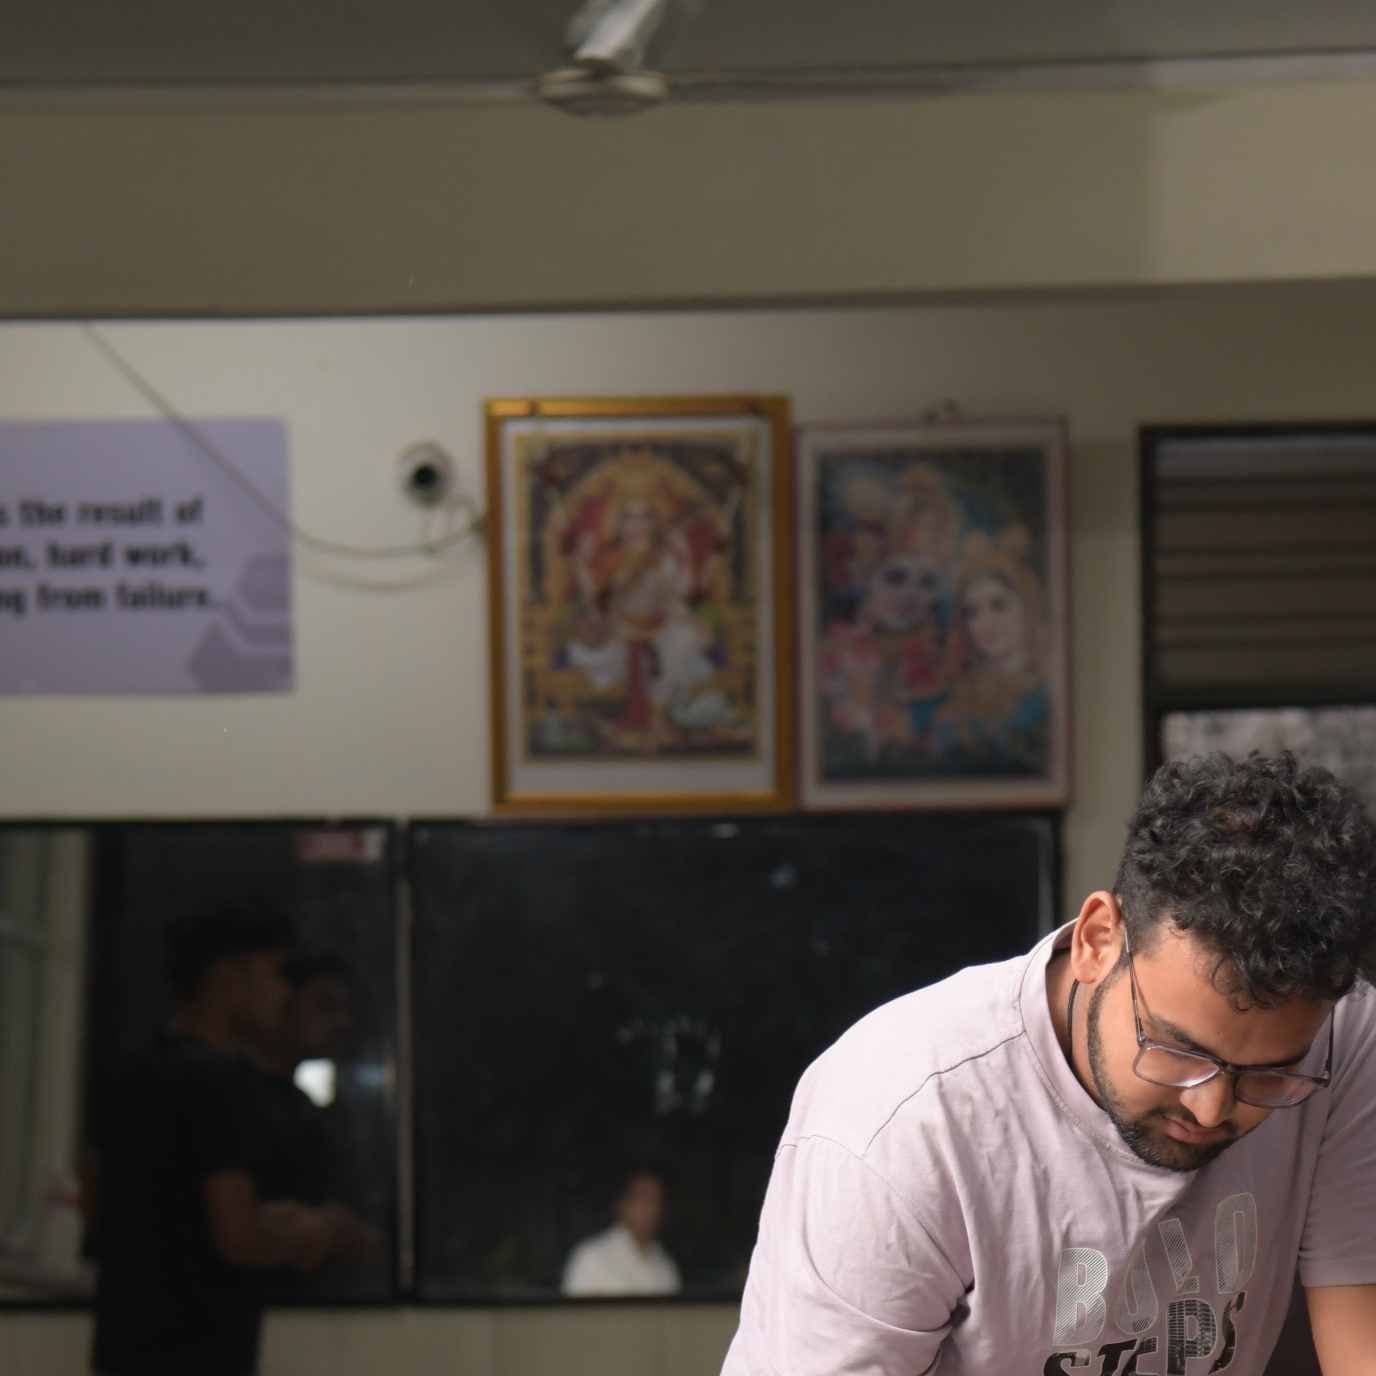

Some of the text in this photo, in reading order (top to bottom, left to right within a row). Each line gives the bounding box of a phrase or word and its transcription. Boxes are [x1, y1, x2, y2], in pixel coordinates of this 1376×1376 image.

[19, 499, 66, 526] the
[76, 498, 164, 525] result
[176, 498, 204, 523] of
[46, 541, 114, 567] hard
[37, 583, 106, 610] from
